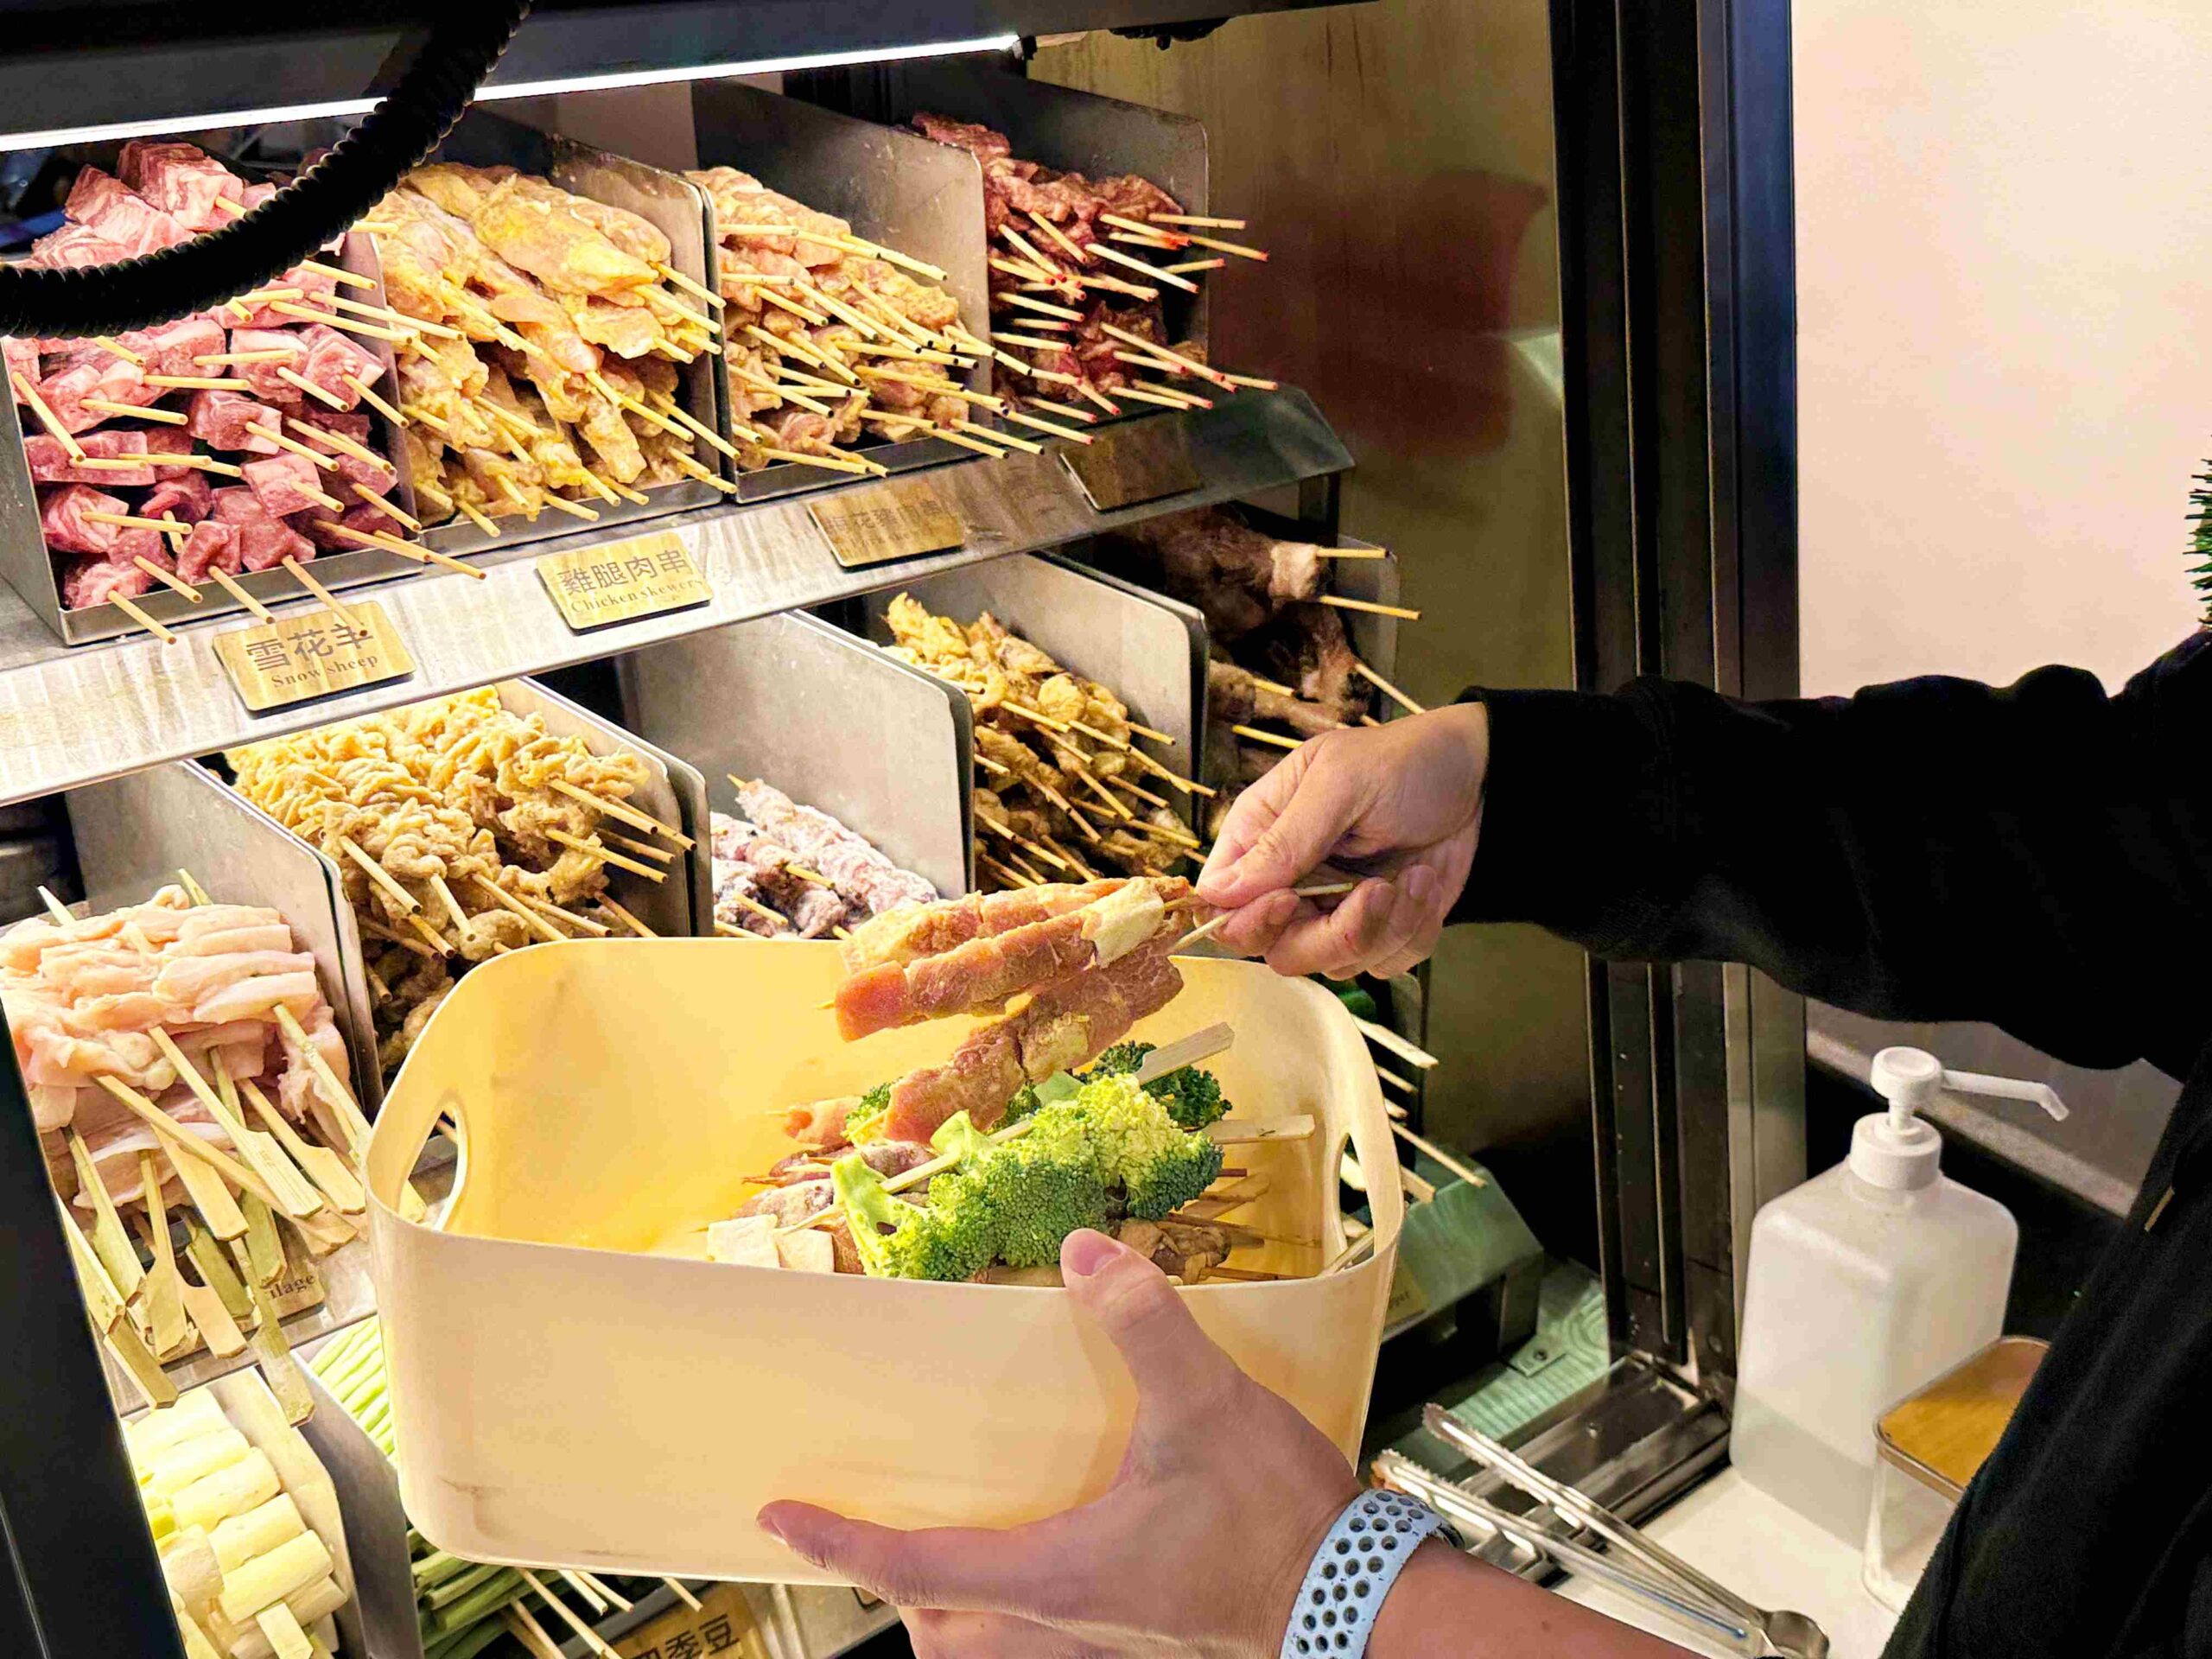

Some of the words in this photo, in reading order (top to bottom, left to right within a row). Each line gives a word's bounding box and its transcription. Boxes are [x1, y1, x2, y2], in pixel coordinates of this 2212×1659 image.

[556, 550, 694, 595] 雞腿肉串
[571, 591, 639, 613] Chicken
[640, 580, 703, 598] skewers
[246, 624, 373, 671] 雪花羊
[270, 669, 322, 688] Snow
[327, 655, 378, 676] sheep
[269, 1275, 315, 1300] ilage
